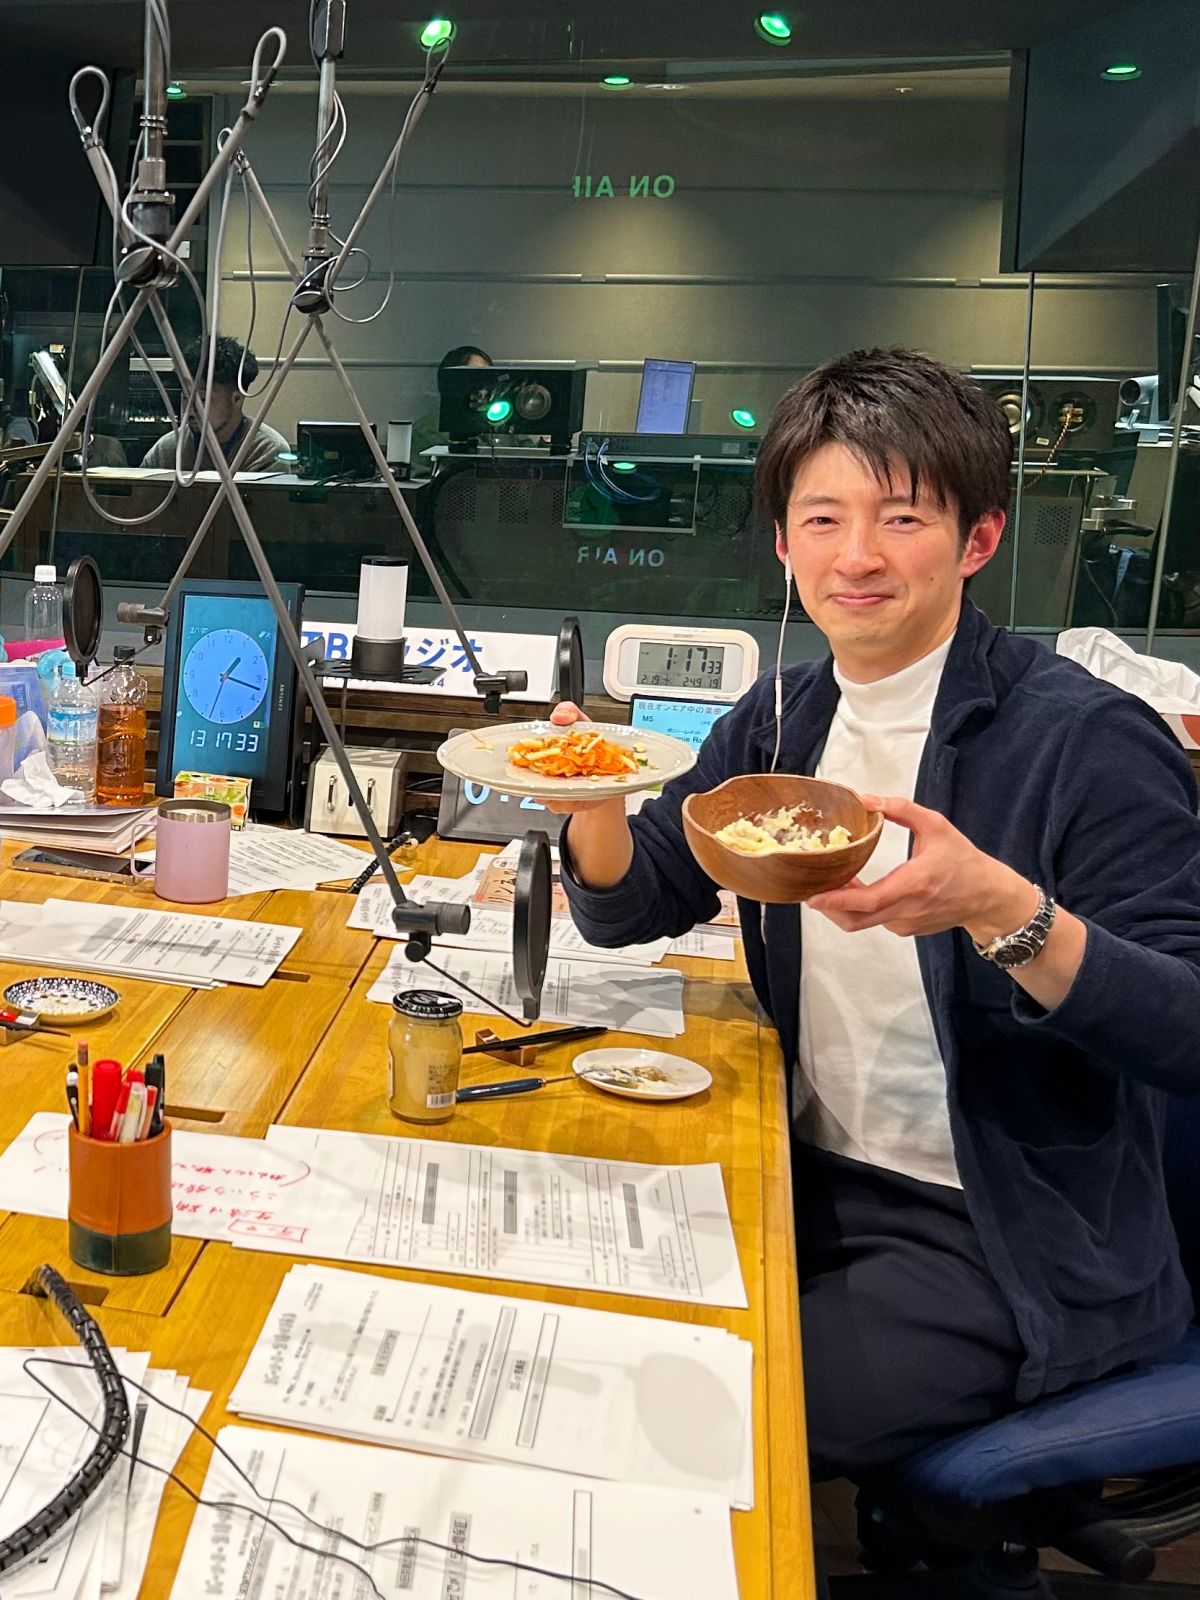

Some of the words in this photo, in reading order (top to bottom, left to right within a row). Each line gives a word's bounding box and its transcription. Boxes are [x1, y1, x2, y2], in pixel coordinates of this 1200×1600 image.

[666, 646, 708, 673] 1:17
[707, 660, 722, 675] 33
[642, 715, 654, 723] M5
[190, 729, 207, 748] 13
[235, 733, 260, 753] 33
